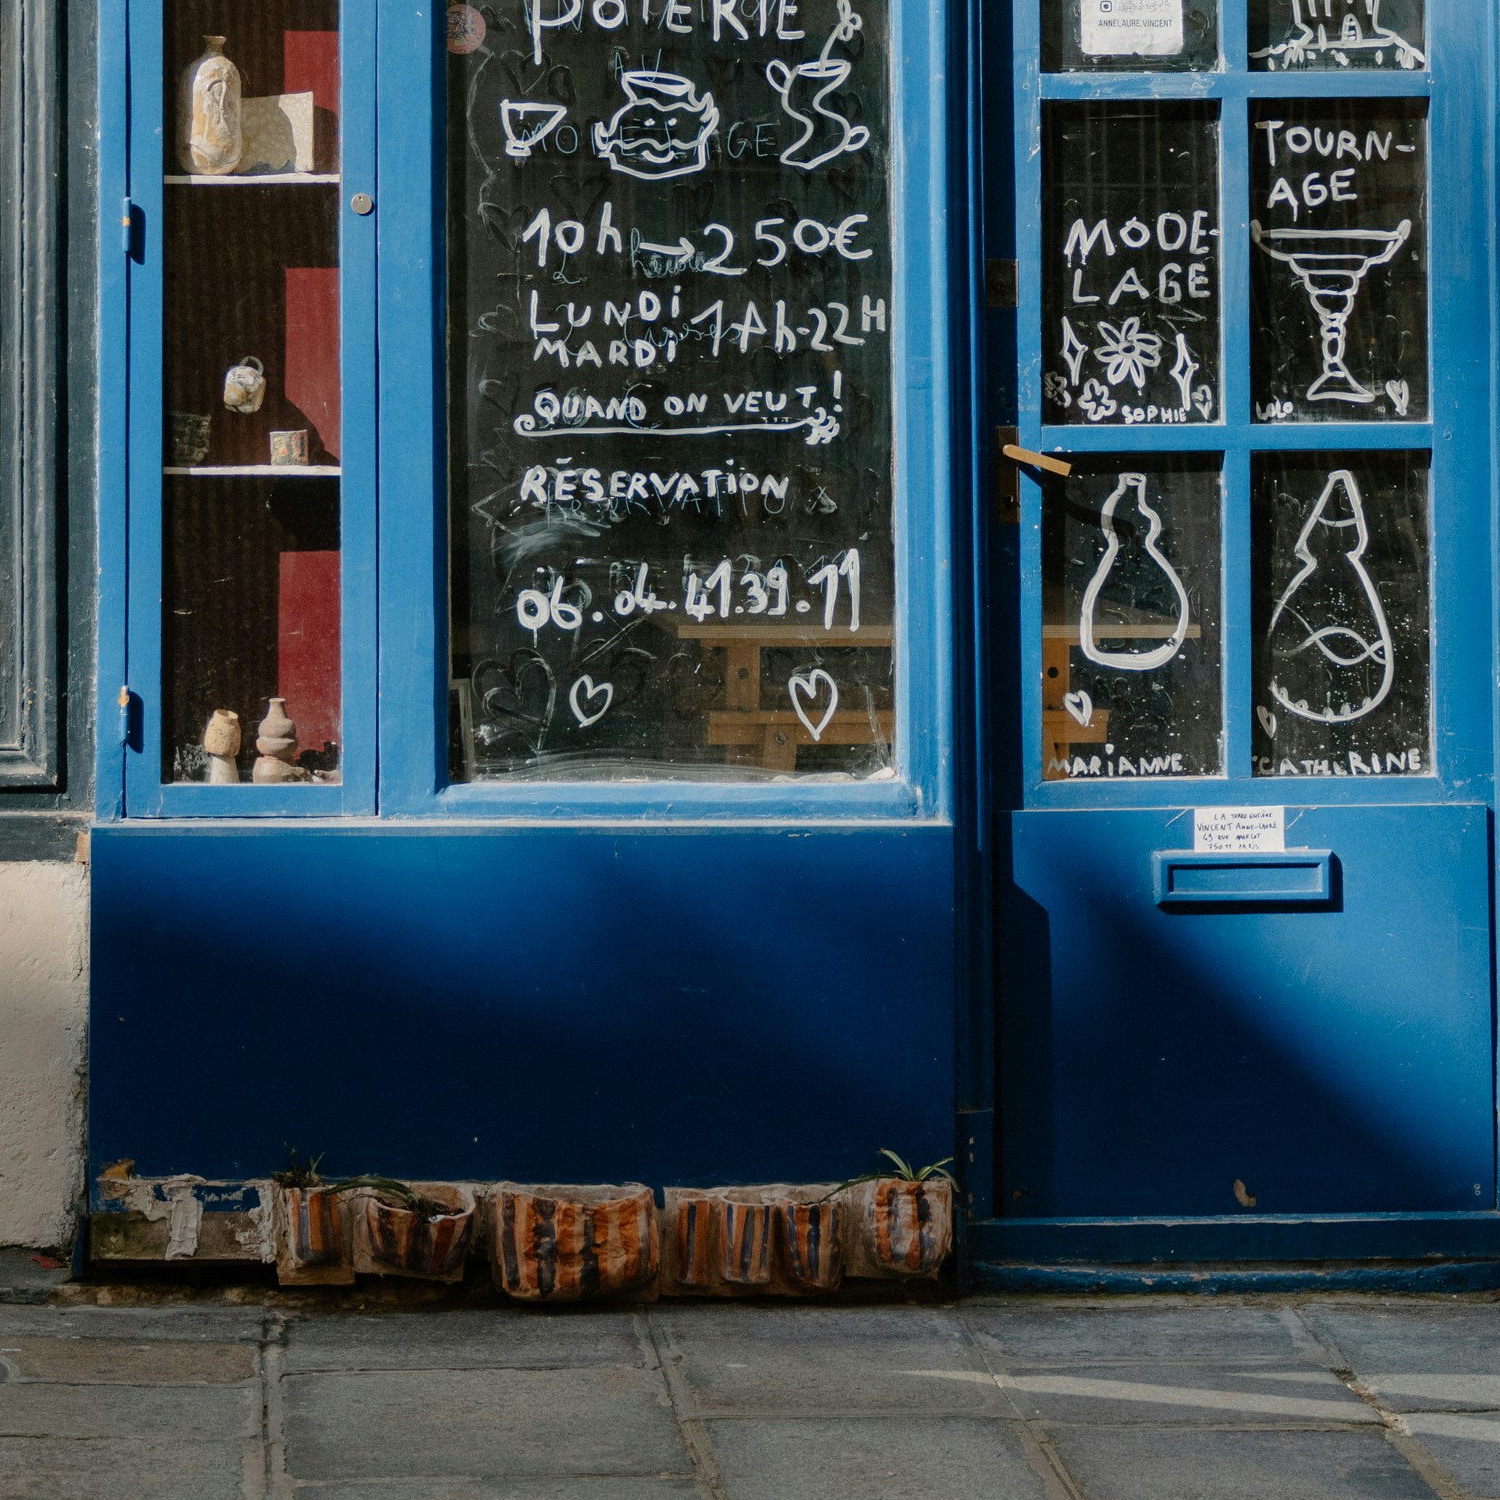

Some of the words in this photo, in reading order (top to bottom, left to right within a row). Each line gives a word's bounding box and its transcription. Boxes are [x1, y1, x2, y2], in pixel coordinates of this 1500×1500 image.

[1098, 19, 1173, 28] ANNELAURE.VINCENT
[1254, 119, 1417, 168] TOURN-
[1266, 167, 1358, 222] AGE
[522, 200, 622, 267] 10h
[702, 213, 874, 276] 250€
[1073, 262, 1211, 306] LAGE
[534, 391, 647, 424] QUAND
[663, 392, 708, 415] ON
